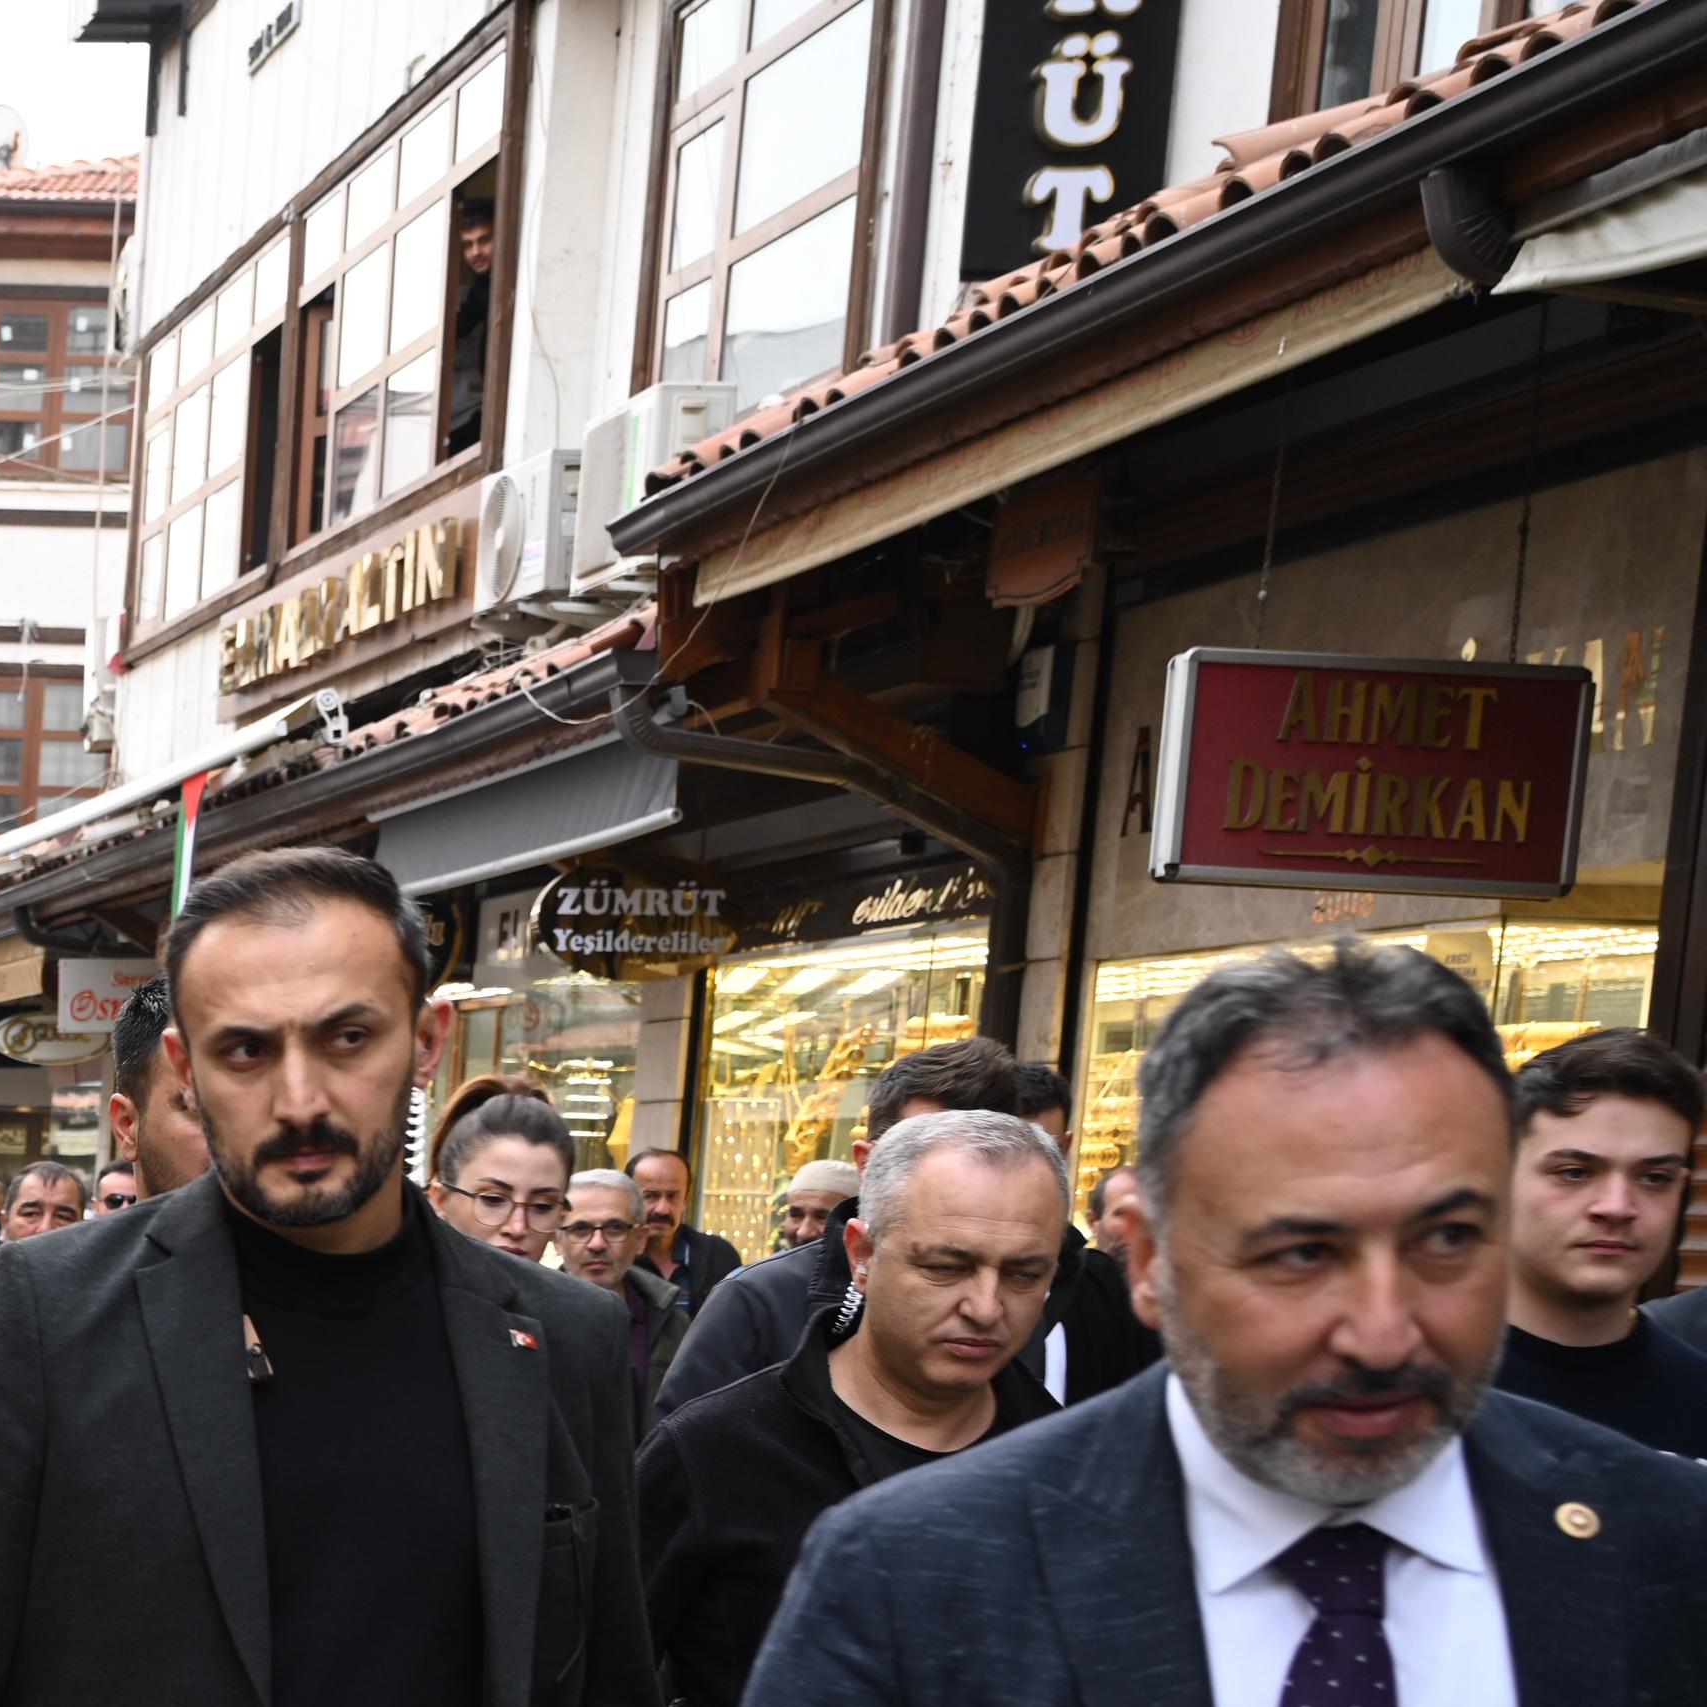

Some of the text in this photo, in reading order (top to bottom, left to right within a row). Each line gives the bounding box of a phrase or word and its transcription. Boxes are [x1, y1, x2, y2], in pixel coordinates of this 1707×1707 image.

[1030, 0, 1140, 252] ÜT
[1277, 669, 1498, 752] AHMET
[1223, 756, 1532, 844] DEMİRKAN
[556, 879, 727, 917] ZÜMRÜT
[552, 927, 728, 956] Yeşildereliler
